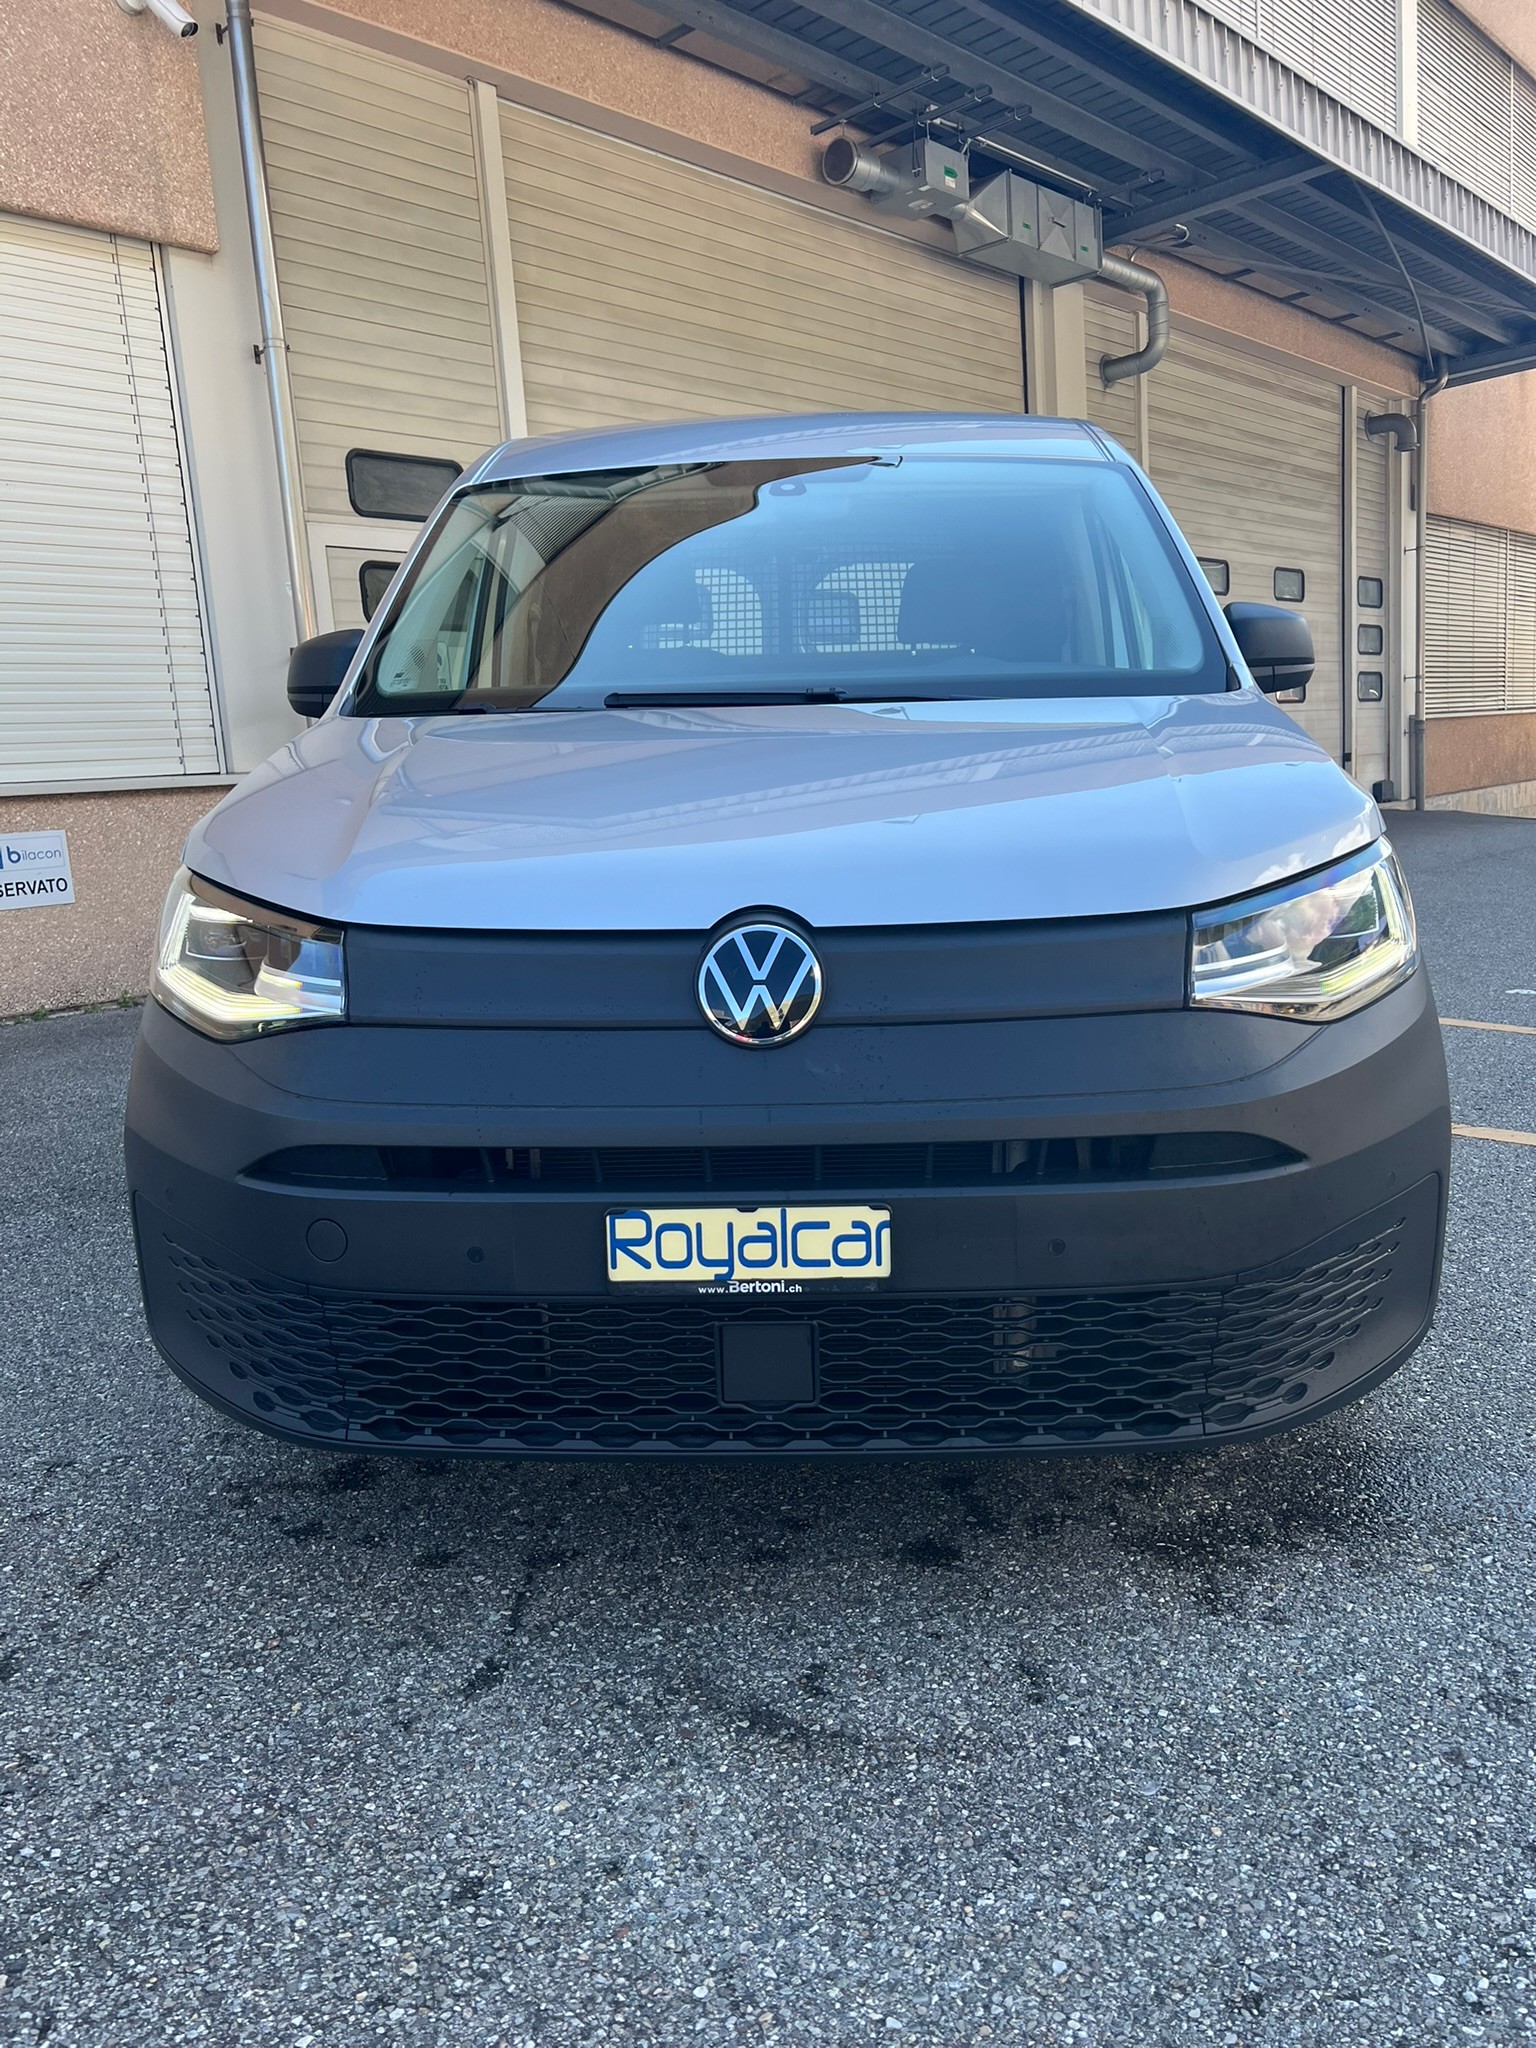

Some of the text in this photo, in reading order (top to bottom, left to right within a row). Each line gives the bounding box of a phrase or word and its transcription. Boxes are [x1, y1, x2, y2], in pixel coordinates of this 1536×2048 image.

[6, 845, 62, 864] bilacon
[608, 1207, 890, 1280] Royalcar
[698, 1280, 803, 1294] www.Bertoni.ch
